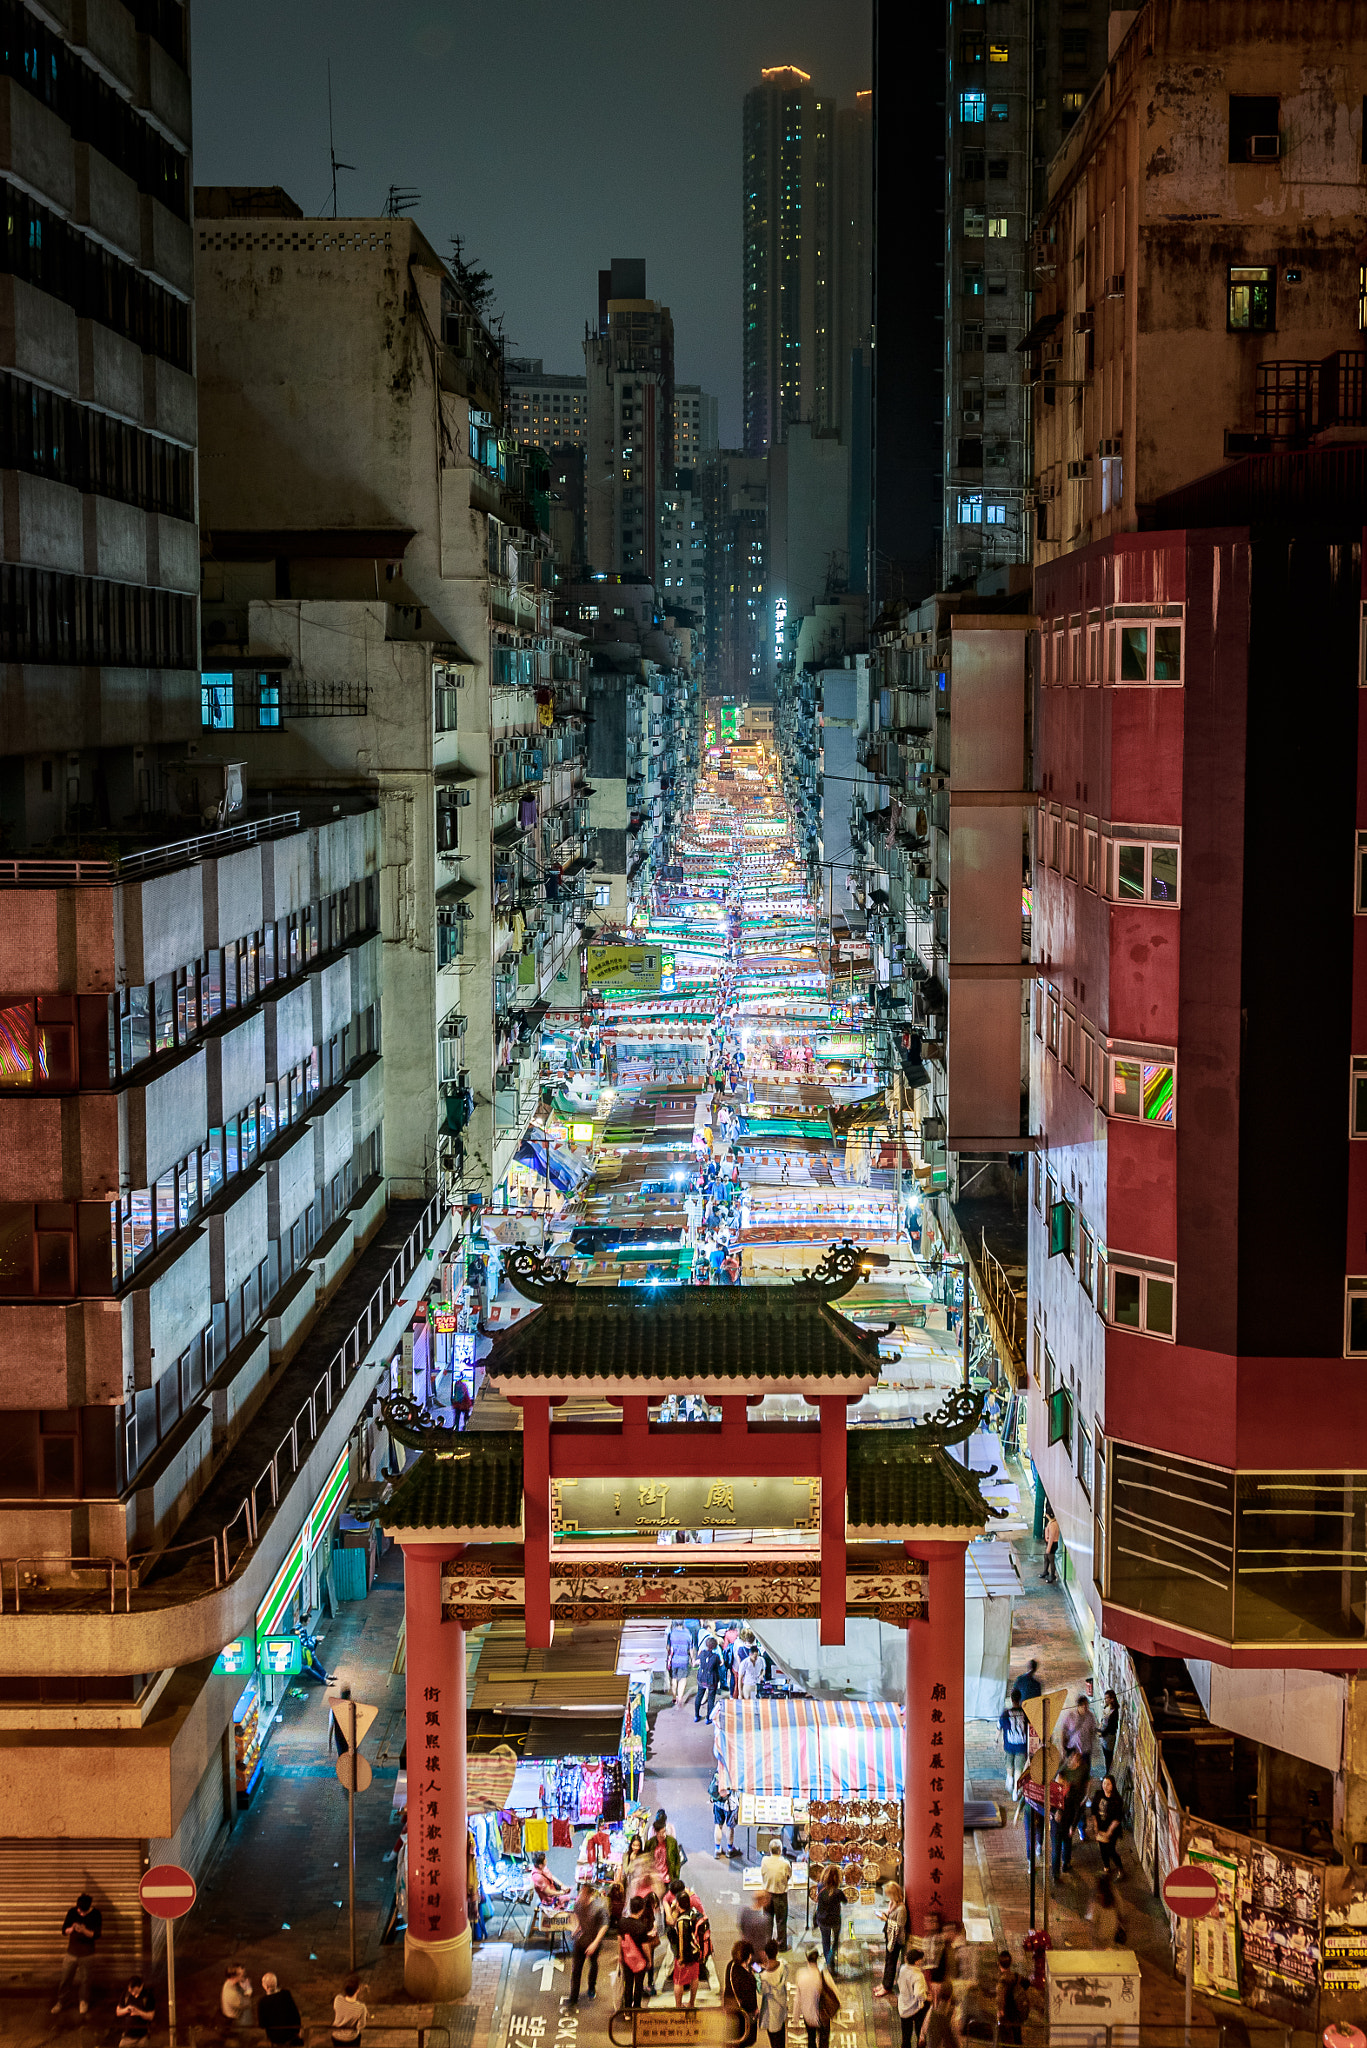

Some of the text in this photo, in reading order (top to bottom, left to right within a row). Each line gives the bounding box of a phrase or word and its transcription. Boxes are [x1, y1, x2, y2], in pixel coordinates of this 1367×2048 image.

[635, 1516, 736, 1527] Temple Street
[1325, 1949, 1345, 1957] 2311
[1324, 1982, 1344, 1990] 2311
